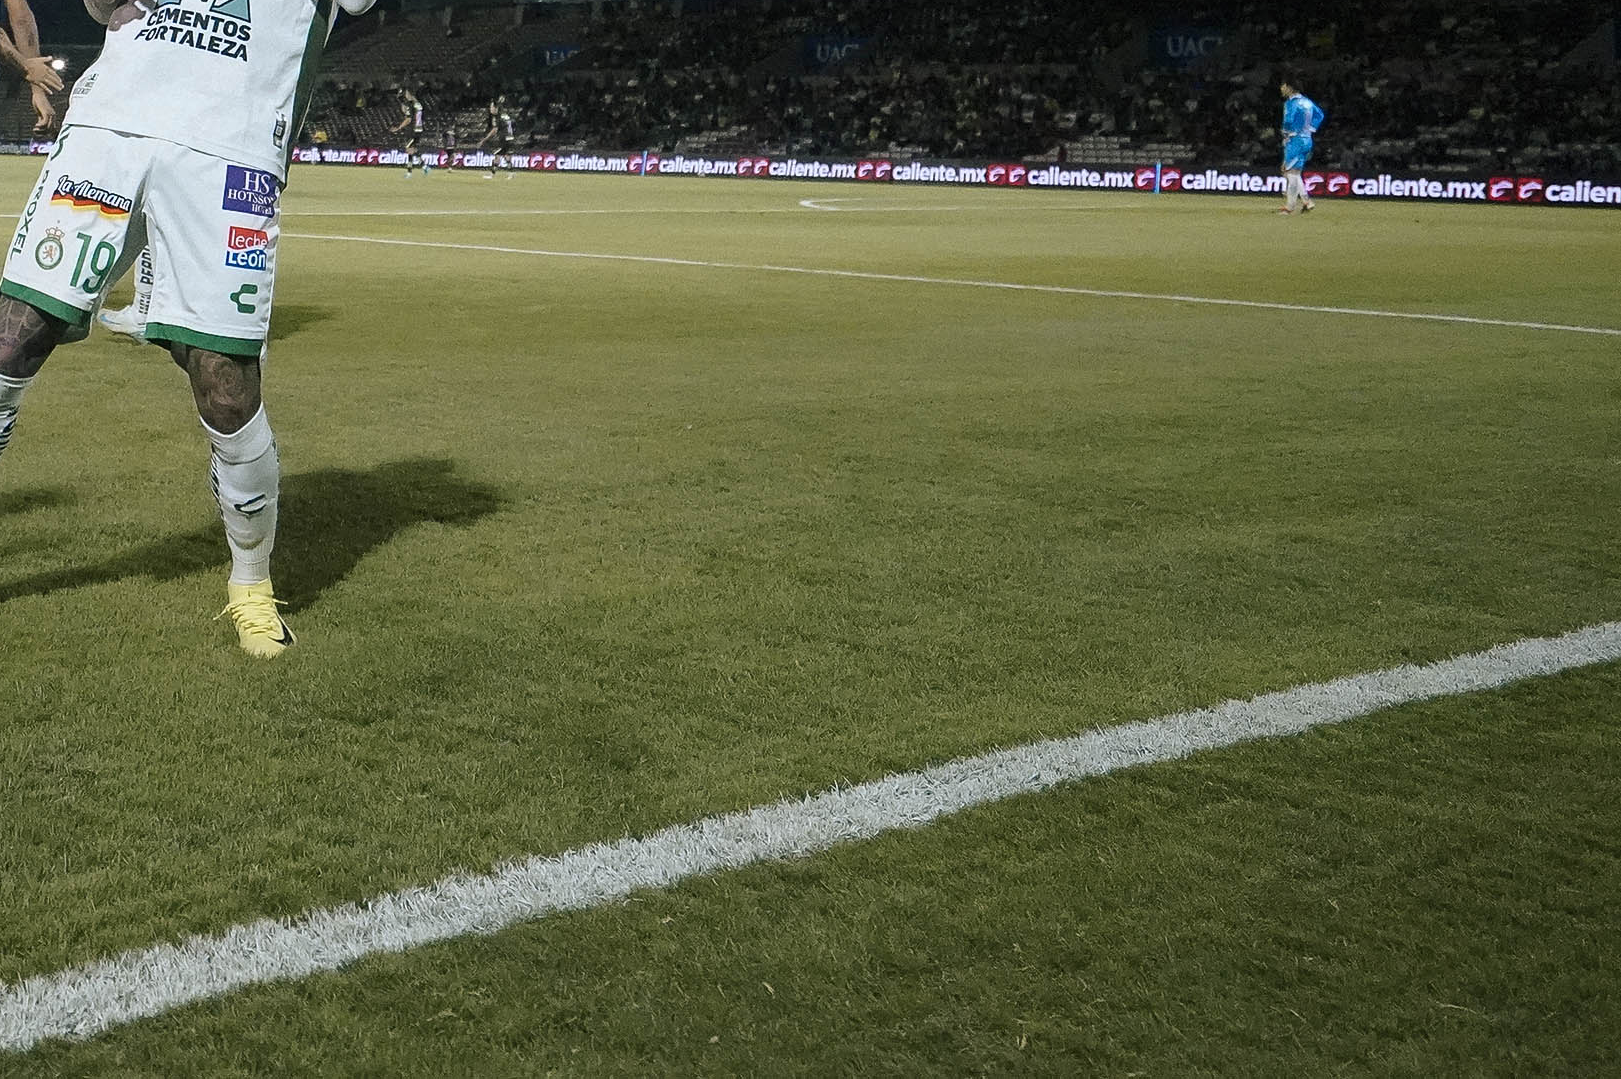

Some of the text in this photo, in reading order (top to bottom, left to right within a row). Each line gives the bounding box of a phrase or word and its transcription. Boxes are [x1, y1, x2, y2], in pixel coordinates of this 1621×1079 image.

[146, 7, 252, 43] CEMENTOS
[133, 25, 249, 63] FORTALEZA
[556, 154, 629, 172] caliente.mx
[658, 156, 738, 177] caliente.mx
[768, 159, 857, 179] caliente.mx
[892, 162, 987, 183] caliente.mx
[242, 169, 271, 195] HS
[1027, 166, 1135, 188] caliente.mx
[1181, 169, 1288, 192] caliente.m
[1351, 174, 1486, 199] caliente.mx
[56, 174, 133, 213] La Alemana
[1545, 180, 1621, 203] calien
[230, 227, 269, 250] leche
[69, 231, 116, 295] 19
